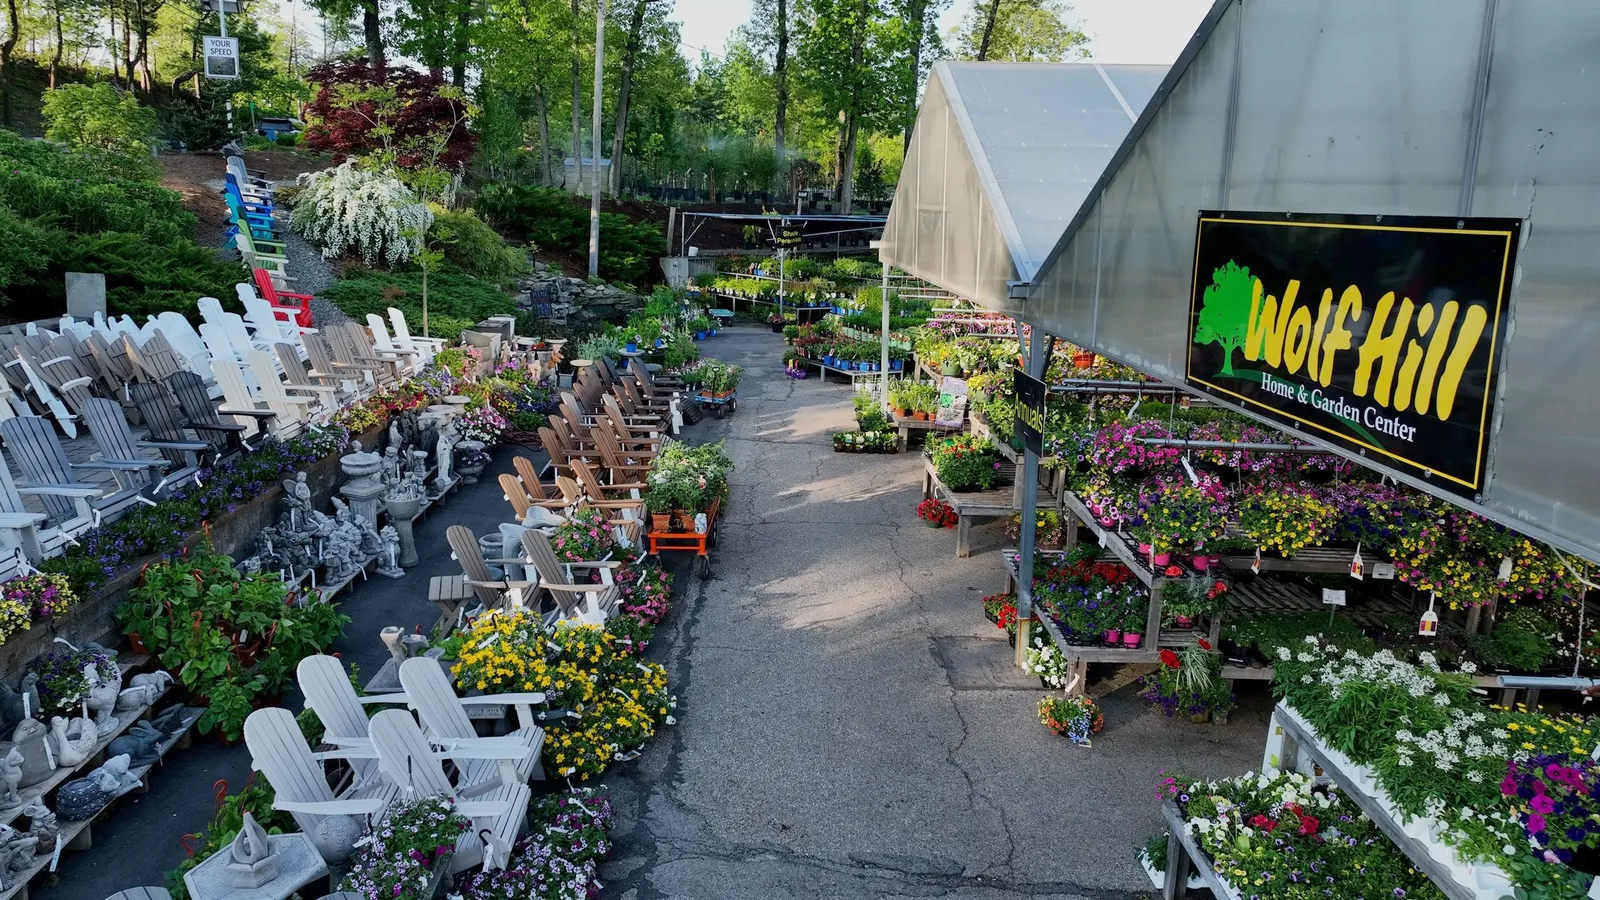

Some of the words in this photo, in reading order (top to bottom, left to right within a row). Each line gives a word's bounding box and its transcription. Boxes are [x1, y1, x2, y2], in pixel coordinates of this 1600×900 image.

[210, 39, 231, 48] YOUR
[210, 47, 232, 56] SPEED
[1244, 279, 1363, 388] Wolf
[1352, 291, 1488, 421] Hill
[1014, 392, 1044, 434] Annuals
[1260, 371, 1295, 400] Home
[1297, 384, 1309, 405] &
[1310, 388, 1361, 424] Garden
[1363, 406, 1417, 443] Center
